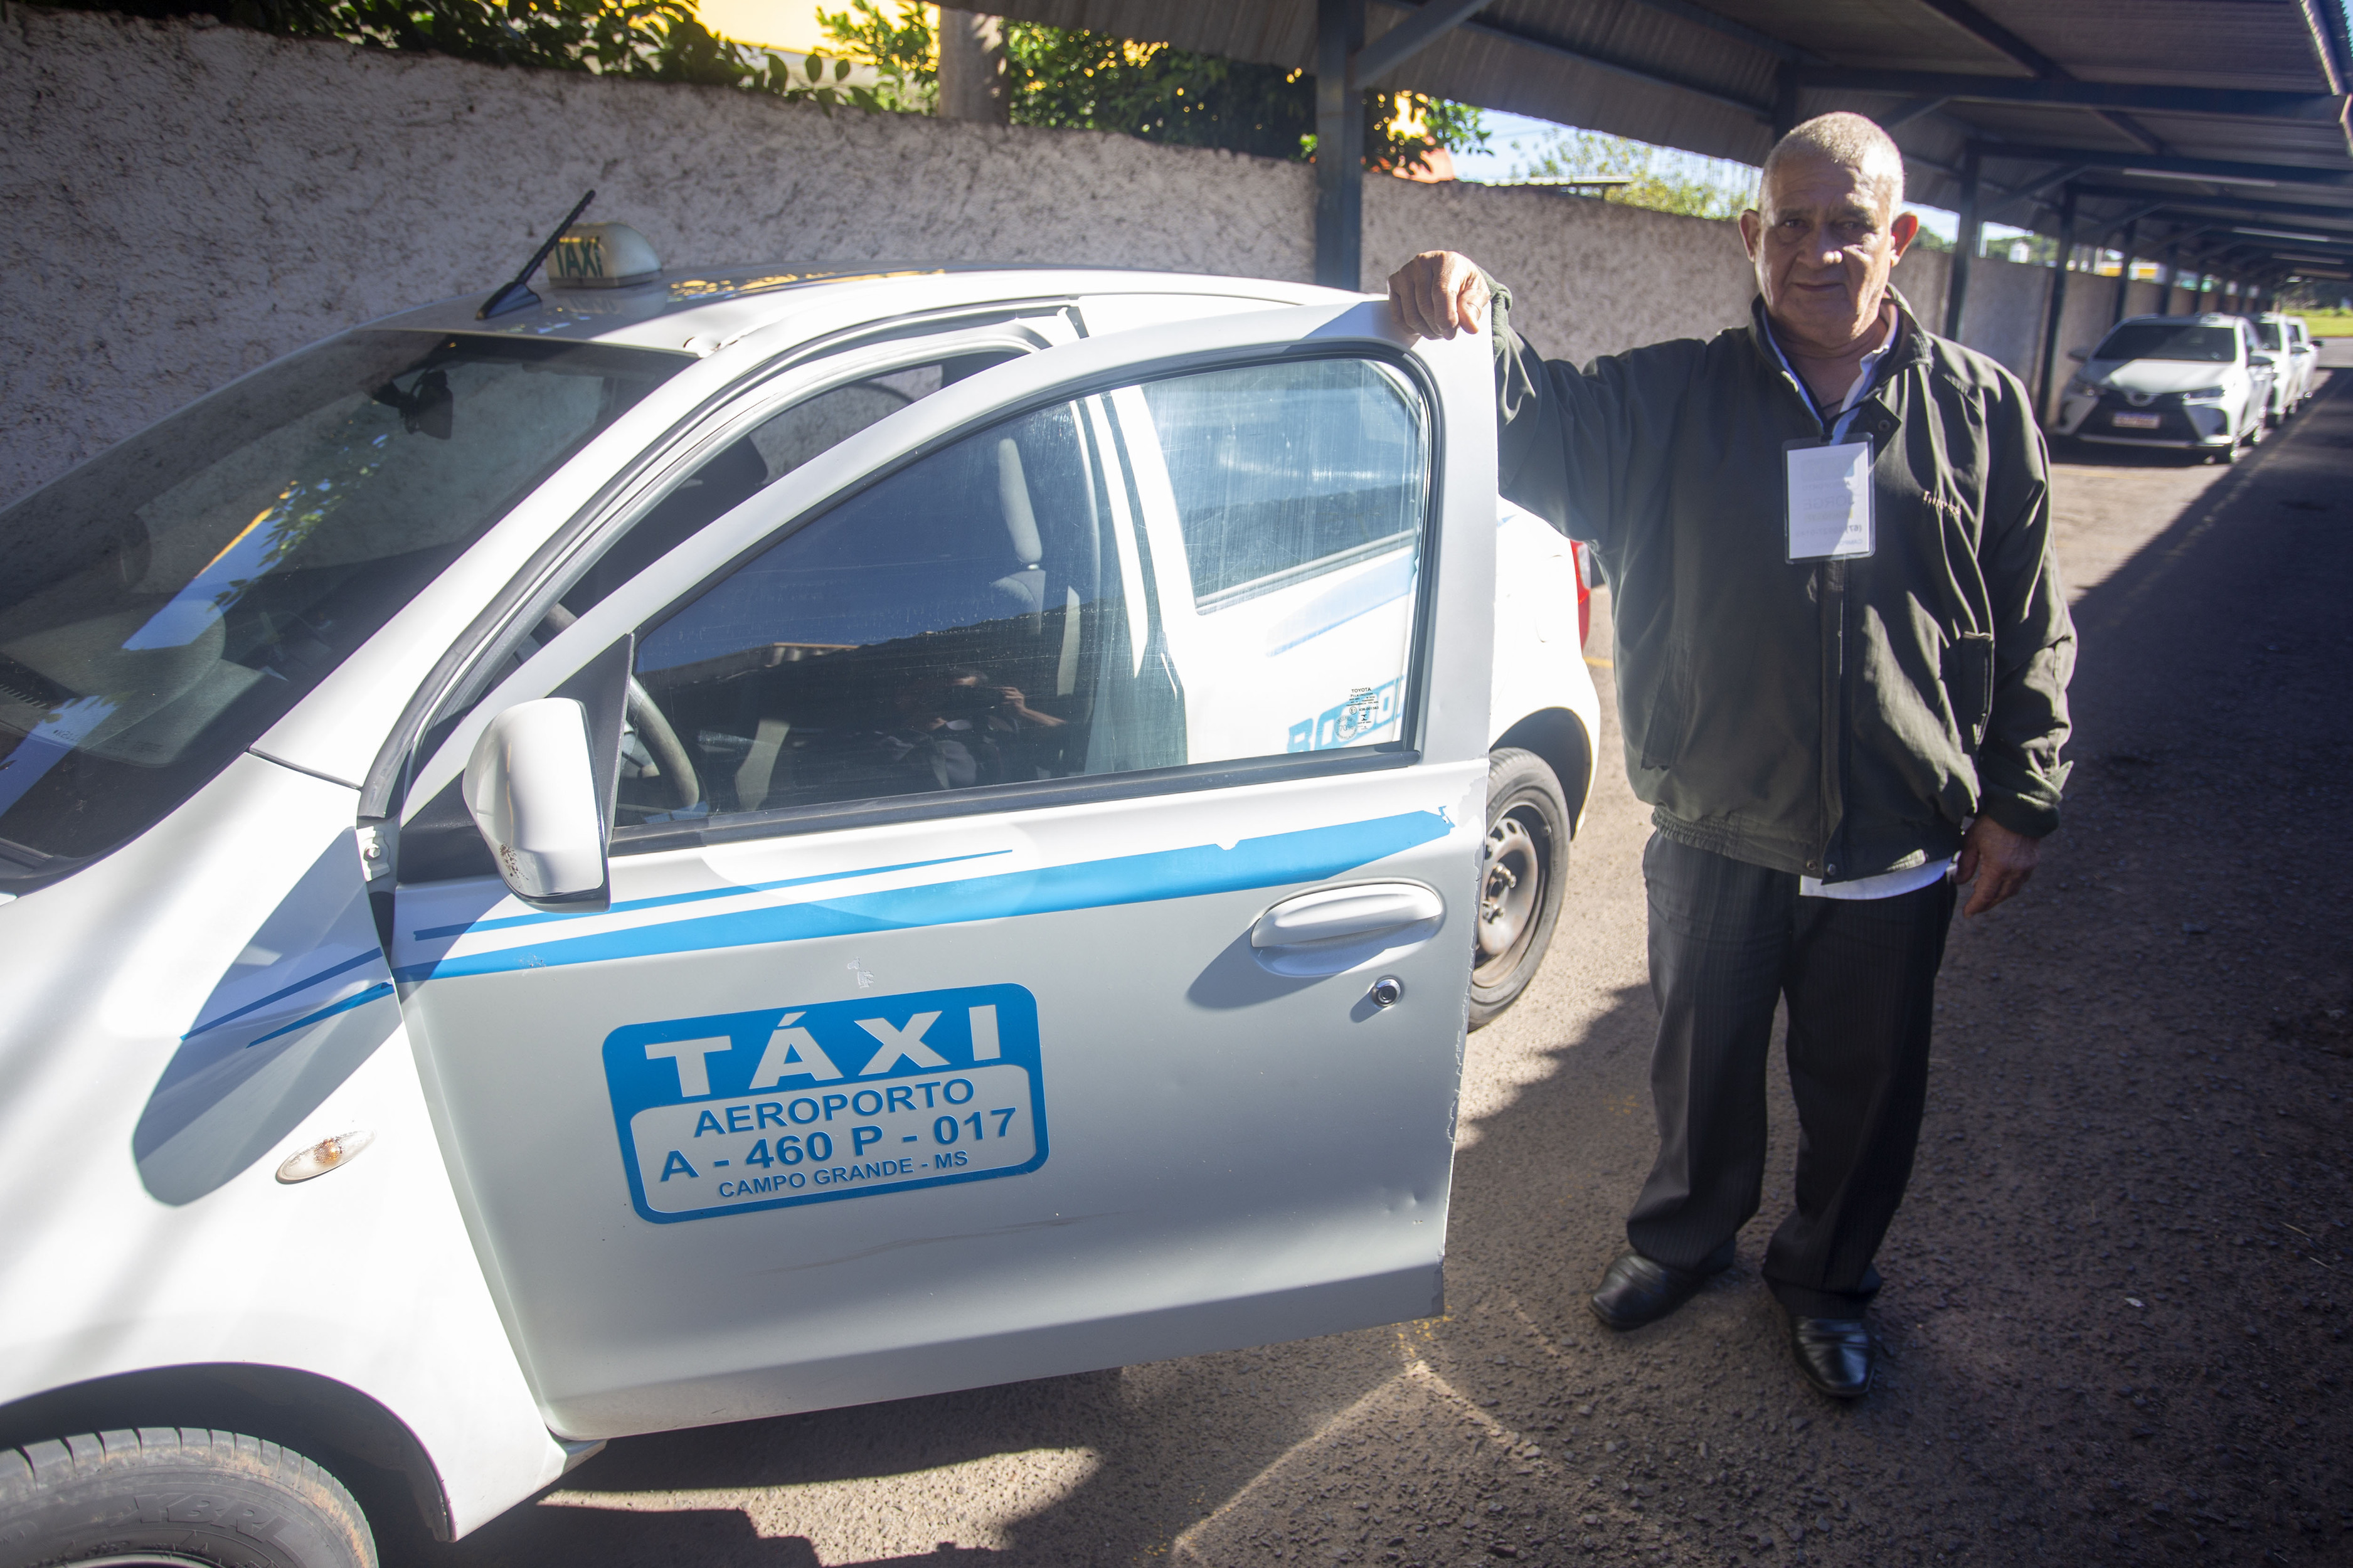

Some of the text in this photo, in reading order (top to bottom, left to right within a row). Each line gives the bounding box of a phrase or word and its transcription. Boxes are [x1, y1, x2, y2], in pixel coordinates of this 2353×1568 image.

[645, 1004, 1001, 1098] TÁXI
[693, 1078, 975, 1138] AEROPORTO
[660, 1107, 1017, 1182] A - 460 P - 017
[719, 1172, 806, 1198] CAMPO
[815, 1158, 915, 1185] GRANDE
[935, 1150, 968, 1170] MS
